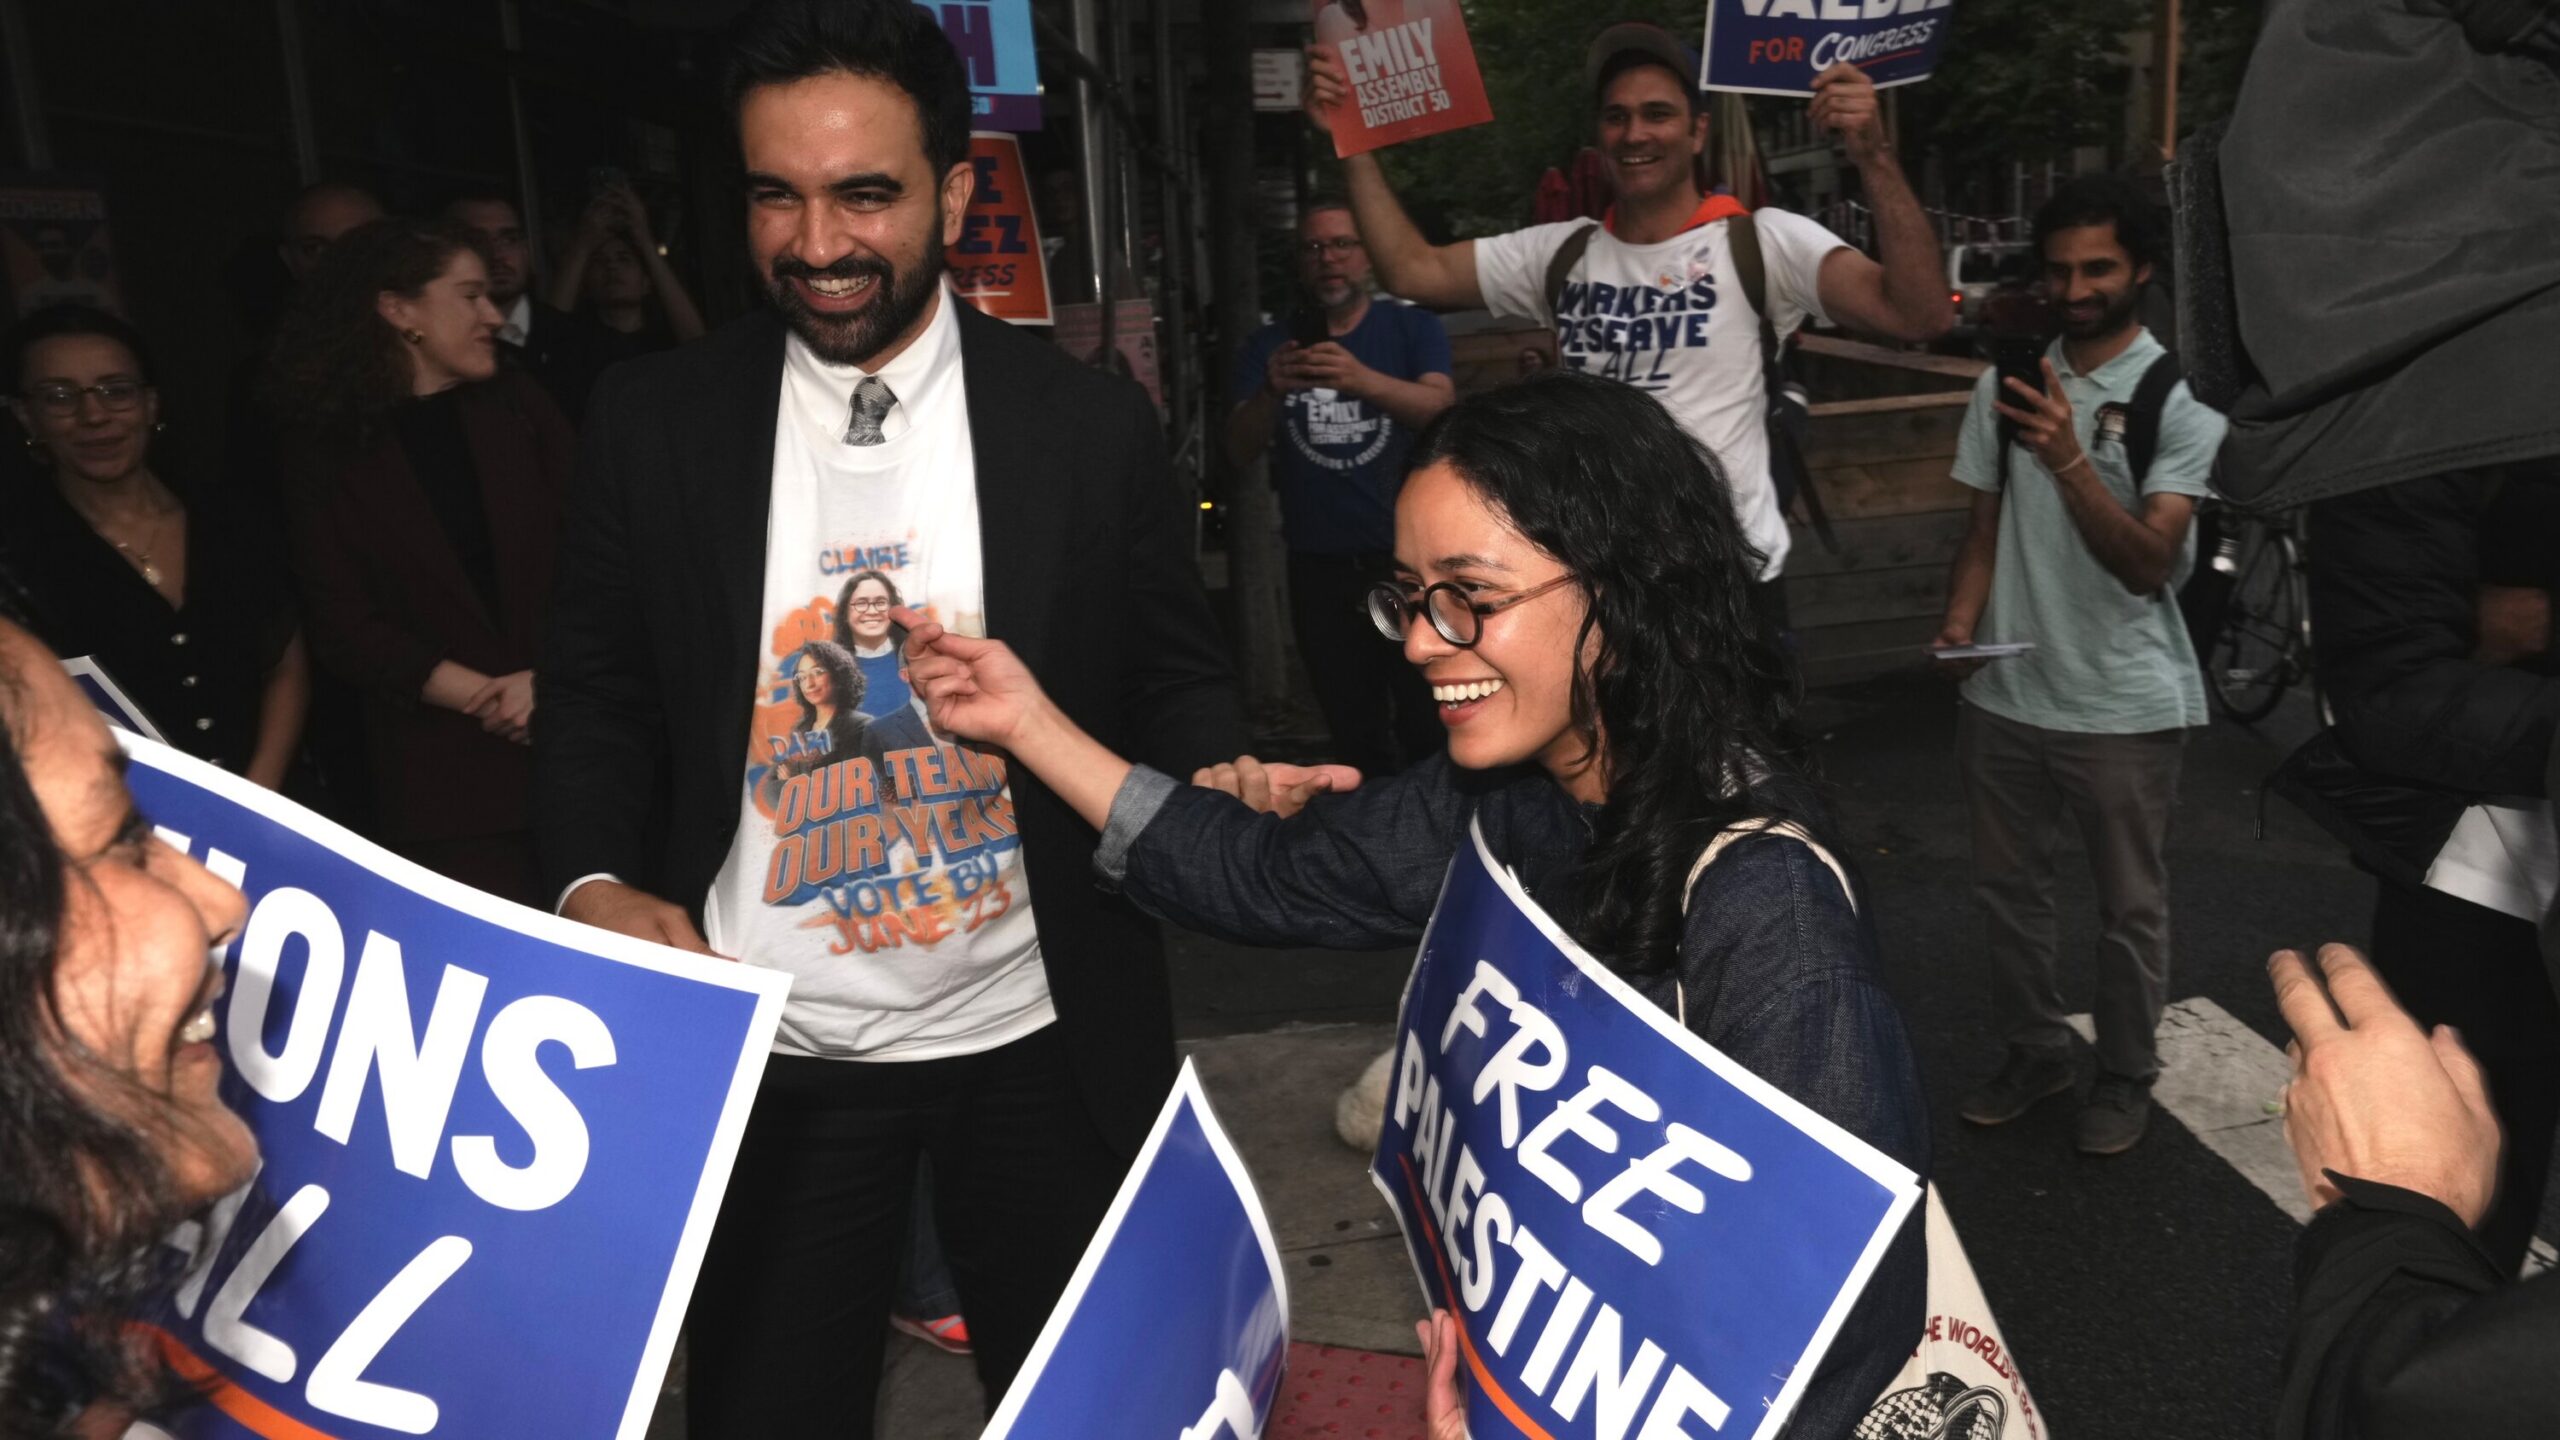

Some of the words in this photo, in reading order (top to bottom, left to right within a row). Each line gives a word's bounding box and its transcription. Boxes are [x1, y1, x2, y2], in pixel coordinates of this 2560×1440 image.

[1339, 17, 1437, 85] EMILY
[1748, 37, 1806, 64] FOR
[1810, 18, 1938, 71] CONGRESS
[1355, 65, 1442, 109] ASSEMBLY
[1361, 95, 1427, 129] DISTRICT
[1429, 89, 1451, 112] 50
[1559, 313, 1709, 353] DESERVE
[1602, 349, 1671, 383] ALL
[1308, 400, 1361, 422] EMILY
[775, 757, 876, 838] OUR
[883, 746, 1008, 799] TEAM
[762, 813, 884, 906] OUR
[893, 796, 1020, 858] YEAR
[821, 869, 942, 919] VOTE
[948, 849, 999, 899] BY
[828, 904, 955, 954] JUNE
[962, 880, 1012, 934] 23
[155, 824, 617, 1211] ONS
[1440, 959, 1752, 1267] FREE
[1948, 1316, 2019, 1396] WORLD'S
